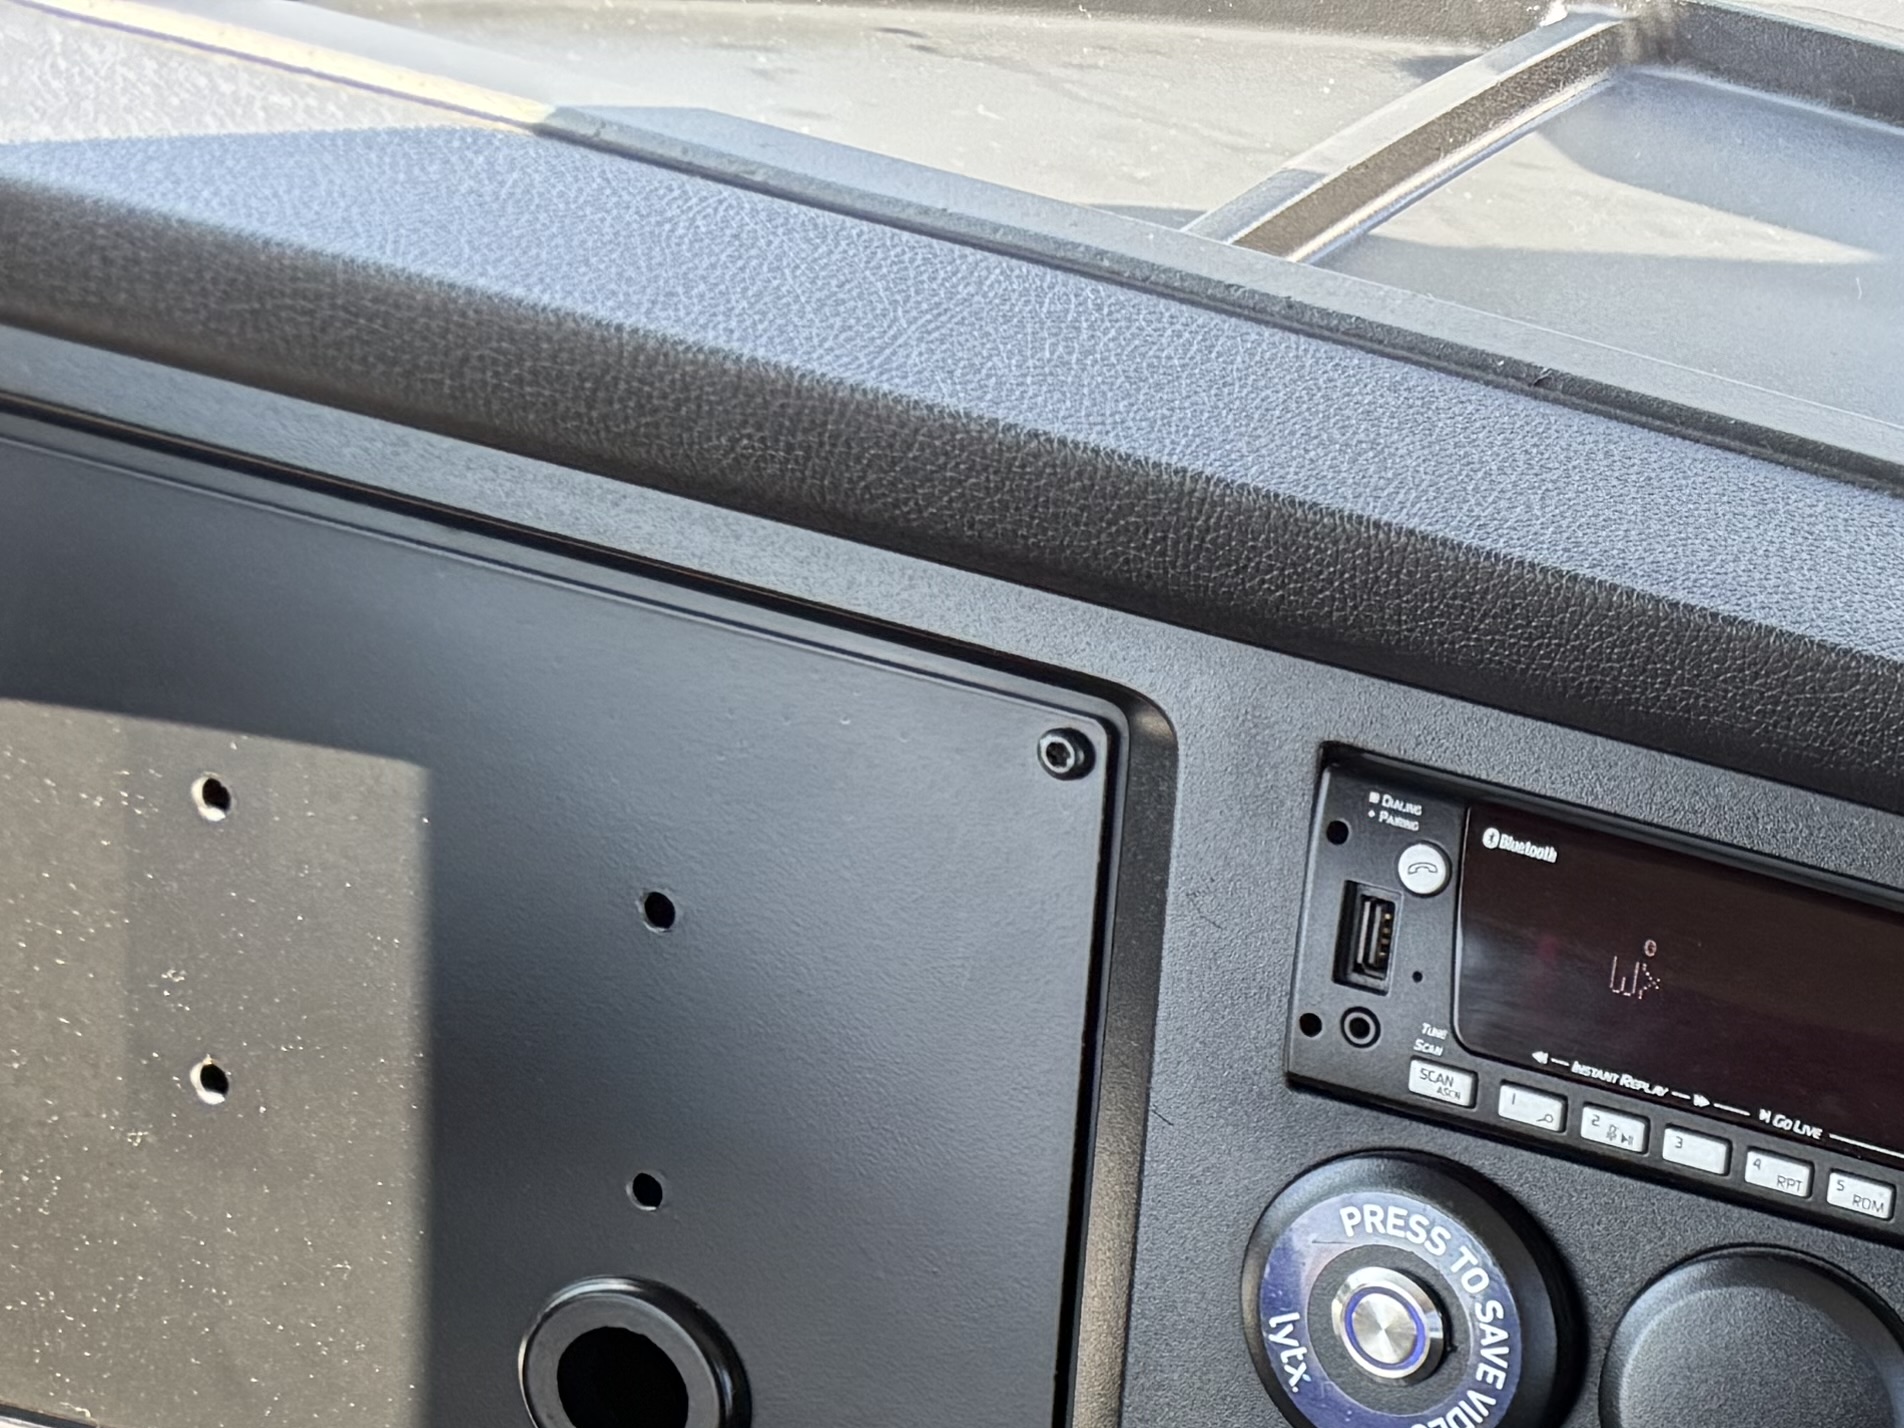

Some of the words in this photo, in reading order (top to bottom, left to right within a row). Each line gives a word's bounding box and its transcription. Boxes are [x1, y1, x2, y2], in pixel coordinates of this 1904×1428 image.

[1499, 833, 1558, 863] Bluetooth
[1418, 1067, 1455, 1087] SCAN
[1570, 1060, 1620, 1085] INSTANT
[1619, 1073, 1669, 1097] REPLAY
[1591, 1115, 1600, 1127] 2
[1674, 1136, 1683, 1149] 3
[1752, 1158, 1762, 1170] 4
[1776, 1175, 1803, 1191] RPT
[1836, 1180, 1845, 1191] 5
[1339, 1204, 1452, 1257] PRESS
[1449, 1245, 1490, 1294] TO
[1474, 1299, 1510, 1390] SAVE
